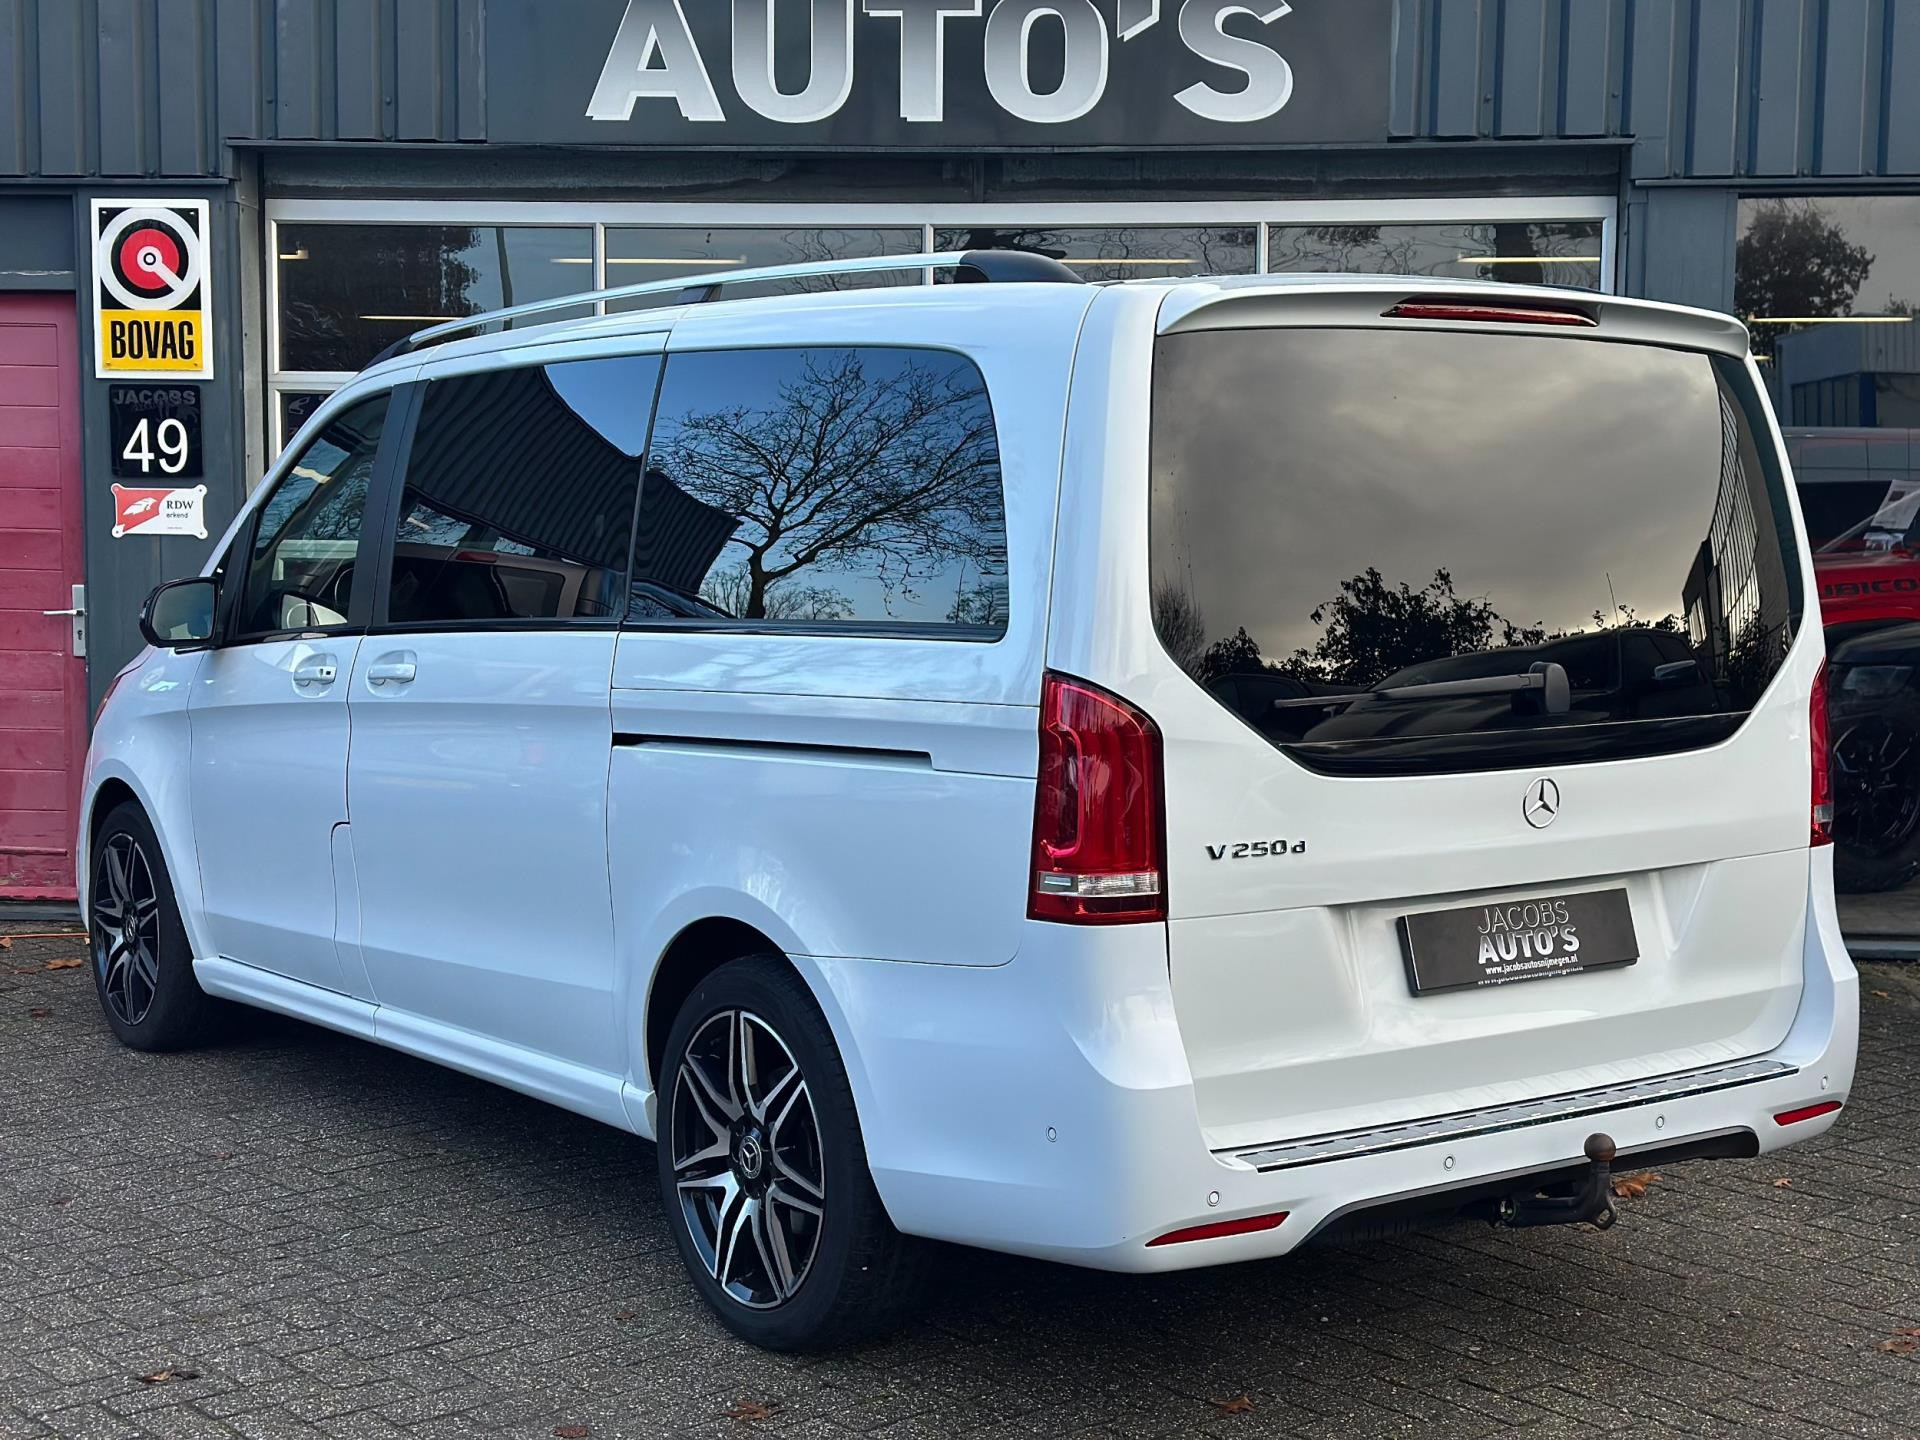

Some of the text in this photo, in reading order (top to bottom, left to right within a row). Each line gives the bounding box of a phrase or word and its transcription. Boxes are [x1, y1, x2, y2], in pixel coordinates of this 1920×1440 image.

[585, 0, 1294, 124] AUTO'S
[110, 320, 195, 360] BOVAG
[113, 389, 197, 406] JACOBS
[122, 417, 189, 474] 49
[166, 500, 194, 510] RDW
[1477, 899, 1570, 934] JACOBS
[1477, 924, 1581, 965] AUTO'S
[1485, 954, 1579, 976] www.jacobsautosnijmegen.nl
